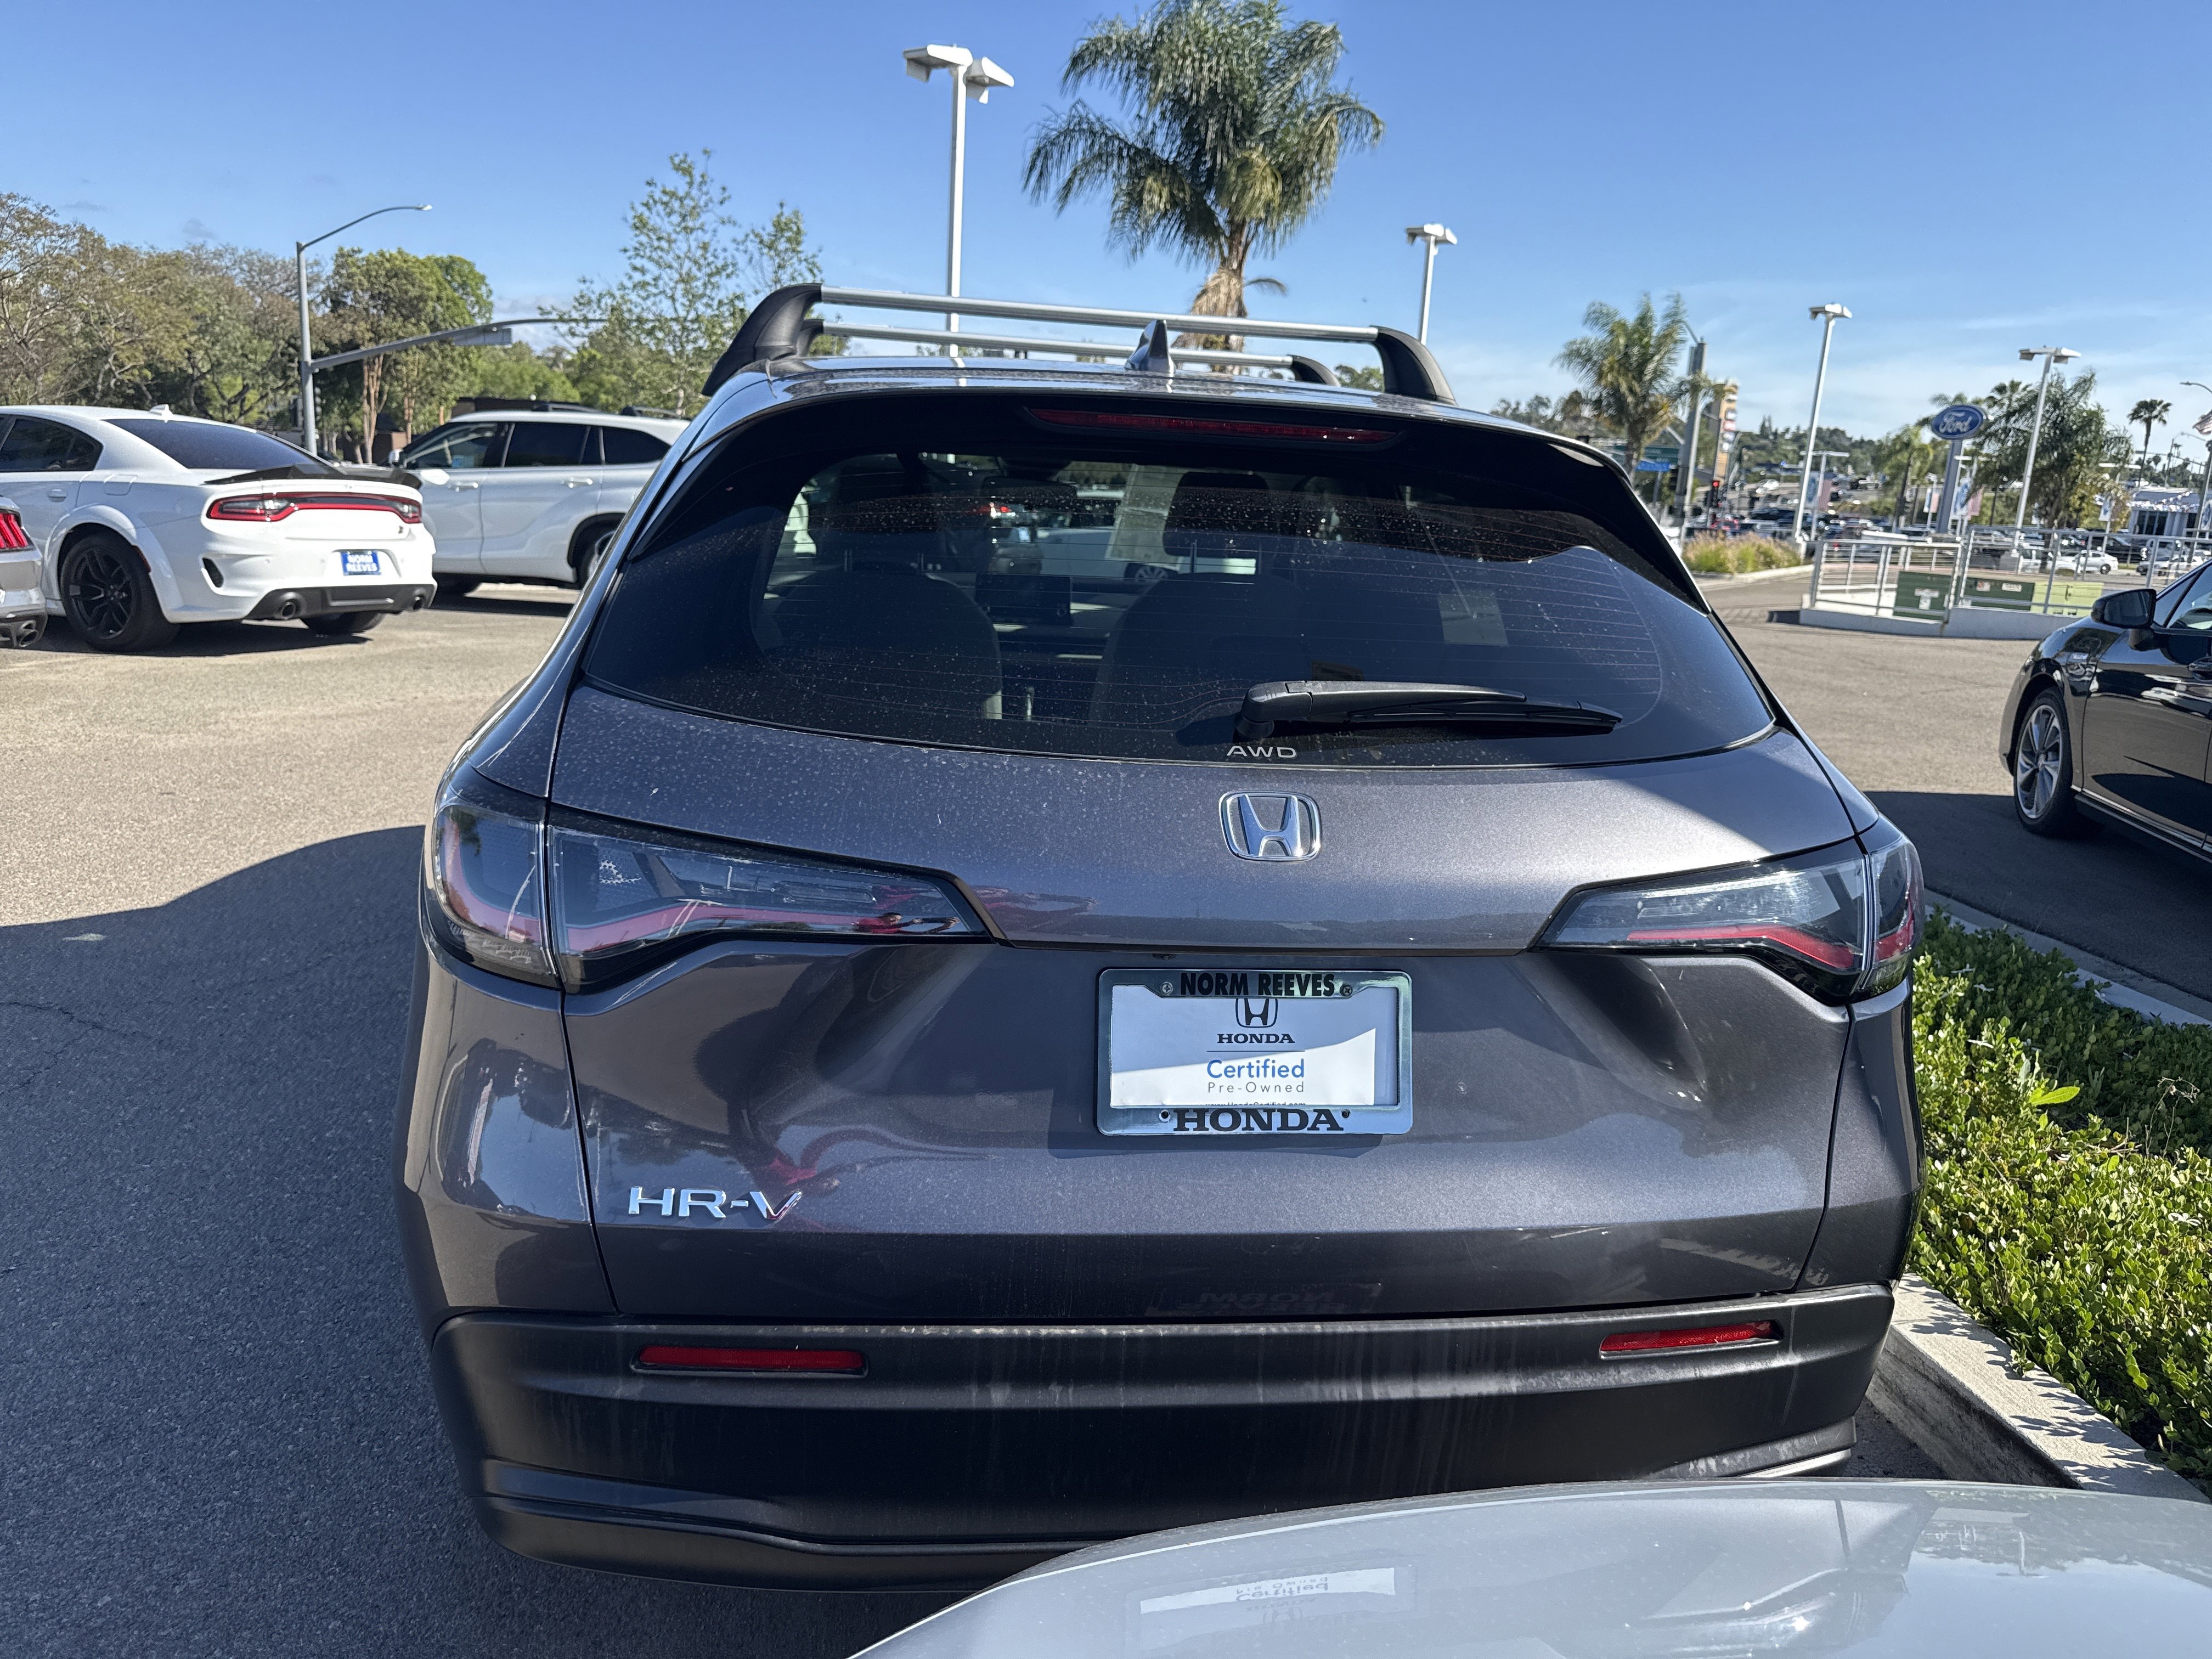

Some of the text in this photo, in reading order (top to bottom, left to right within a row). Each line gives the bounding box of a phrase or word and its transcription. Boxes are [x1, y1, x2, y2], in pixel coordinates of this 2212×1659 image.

[1939, 411, 1973, 433] Ford
[1226, 746, 1297, 758] AWD
[1180, 972, 1335, 997] NORM REEVES
[1217, 1034, 1295, 1043] HONDA
[1207, 1059, 1305, 1078] Certified
[1208, 1082, 1304, 1093] Pre-Owned
[1173, 1109, 1344, 1132] HONDA
[629, 1186, 803, 1220] HR-V
